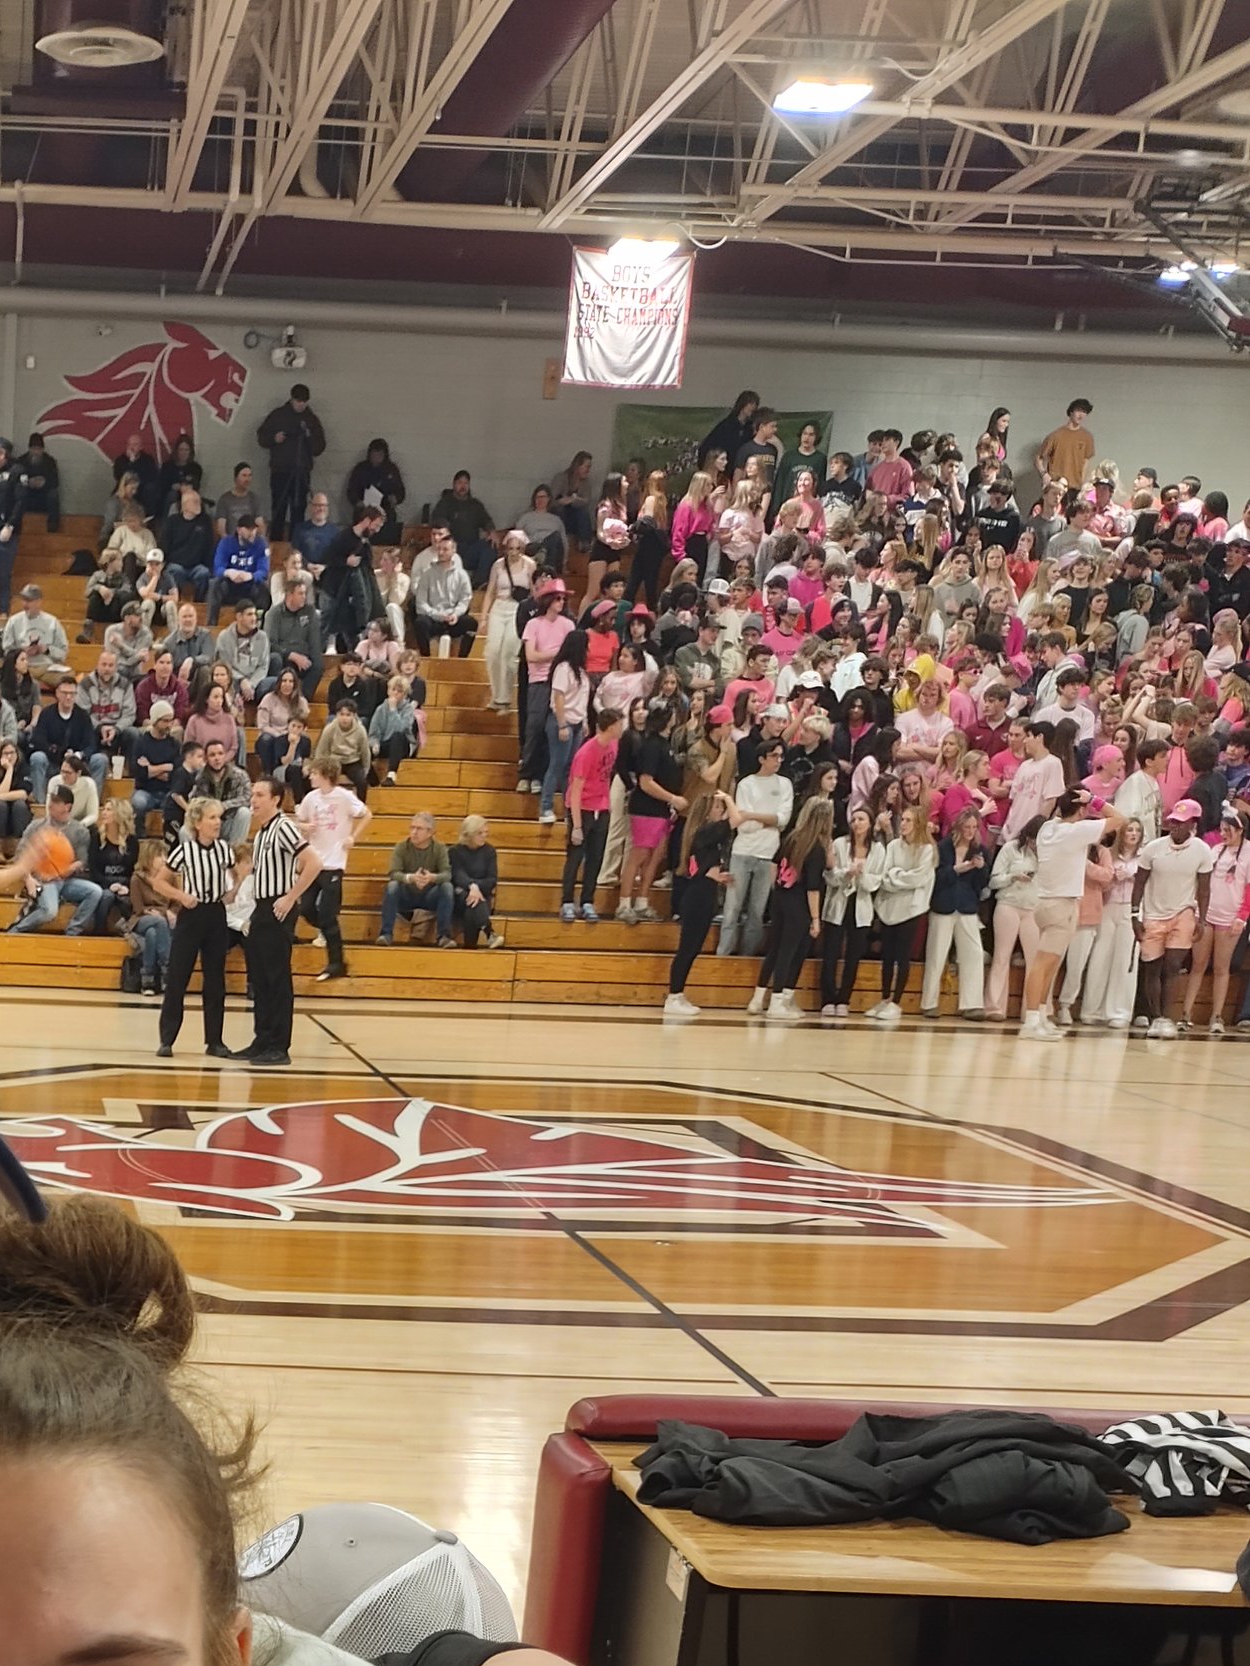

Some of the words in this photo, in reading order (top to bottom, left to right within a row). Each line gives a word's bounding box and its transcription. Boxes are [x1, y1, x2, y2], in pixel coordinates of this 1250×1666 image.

[611, 264, 651, 284] BOYS
[582, 281, 678, 304] BASKETBALL
[578, 303, 610, 323] STATE
[617, 307, 678, 326] CHAMPIONS
